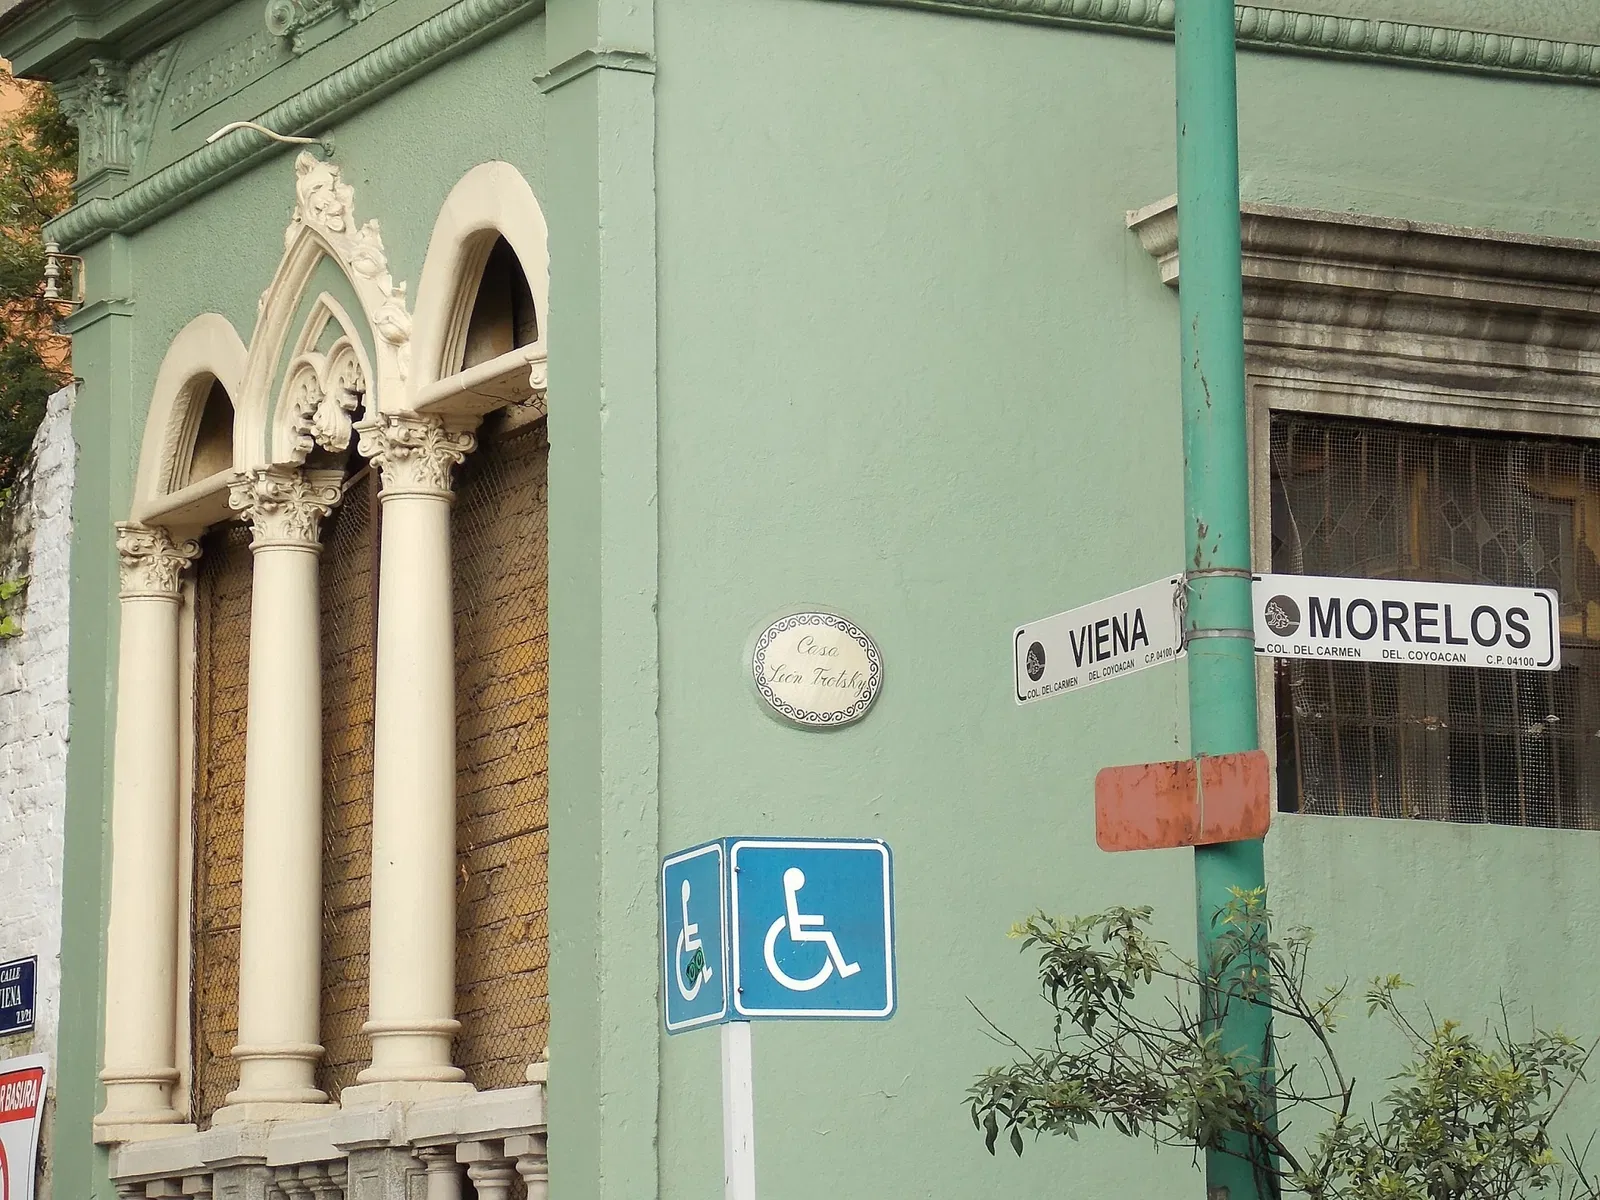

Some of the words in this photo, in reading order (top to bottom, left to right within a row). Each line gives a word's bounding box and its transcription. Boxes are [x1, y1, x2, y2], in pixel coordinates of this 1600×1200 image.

[1069, 608, 1149, 668] VIENA
[1308, 596, 1531, 649] MORELOS
[797, 635, 840, 657] Casa
[1266, 643, 1290, 655] COL.
[1293, 645, 1314, 656] DEL
[1316, 646, 1361, 658] CARMEN
[1382, 649, 1405, 660] DEL.
[1408, 650, 1467, 663] COYOACAN
[1486, 654, 1504, 665] C.P.
[1506, 656, 1535, 667] 04100
[810, 667, 868, 698] Trotsky
[1027, 688, 1040, 700] COL.
[1041, 684, 1053, 696] DEL
[1053, 676, 1079, 692] CARMEN
[1088, 670, 1102, 681] DEL.
[1102, 659, 1135, 677] COYOACAN
[1145, 652, 1156, 664] C.P.
[1156, 647, 1173, 661] 04100
[0, 966, 21, 983] CALLE
[5, 1079, 37, 1112] BASURA
